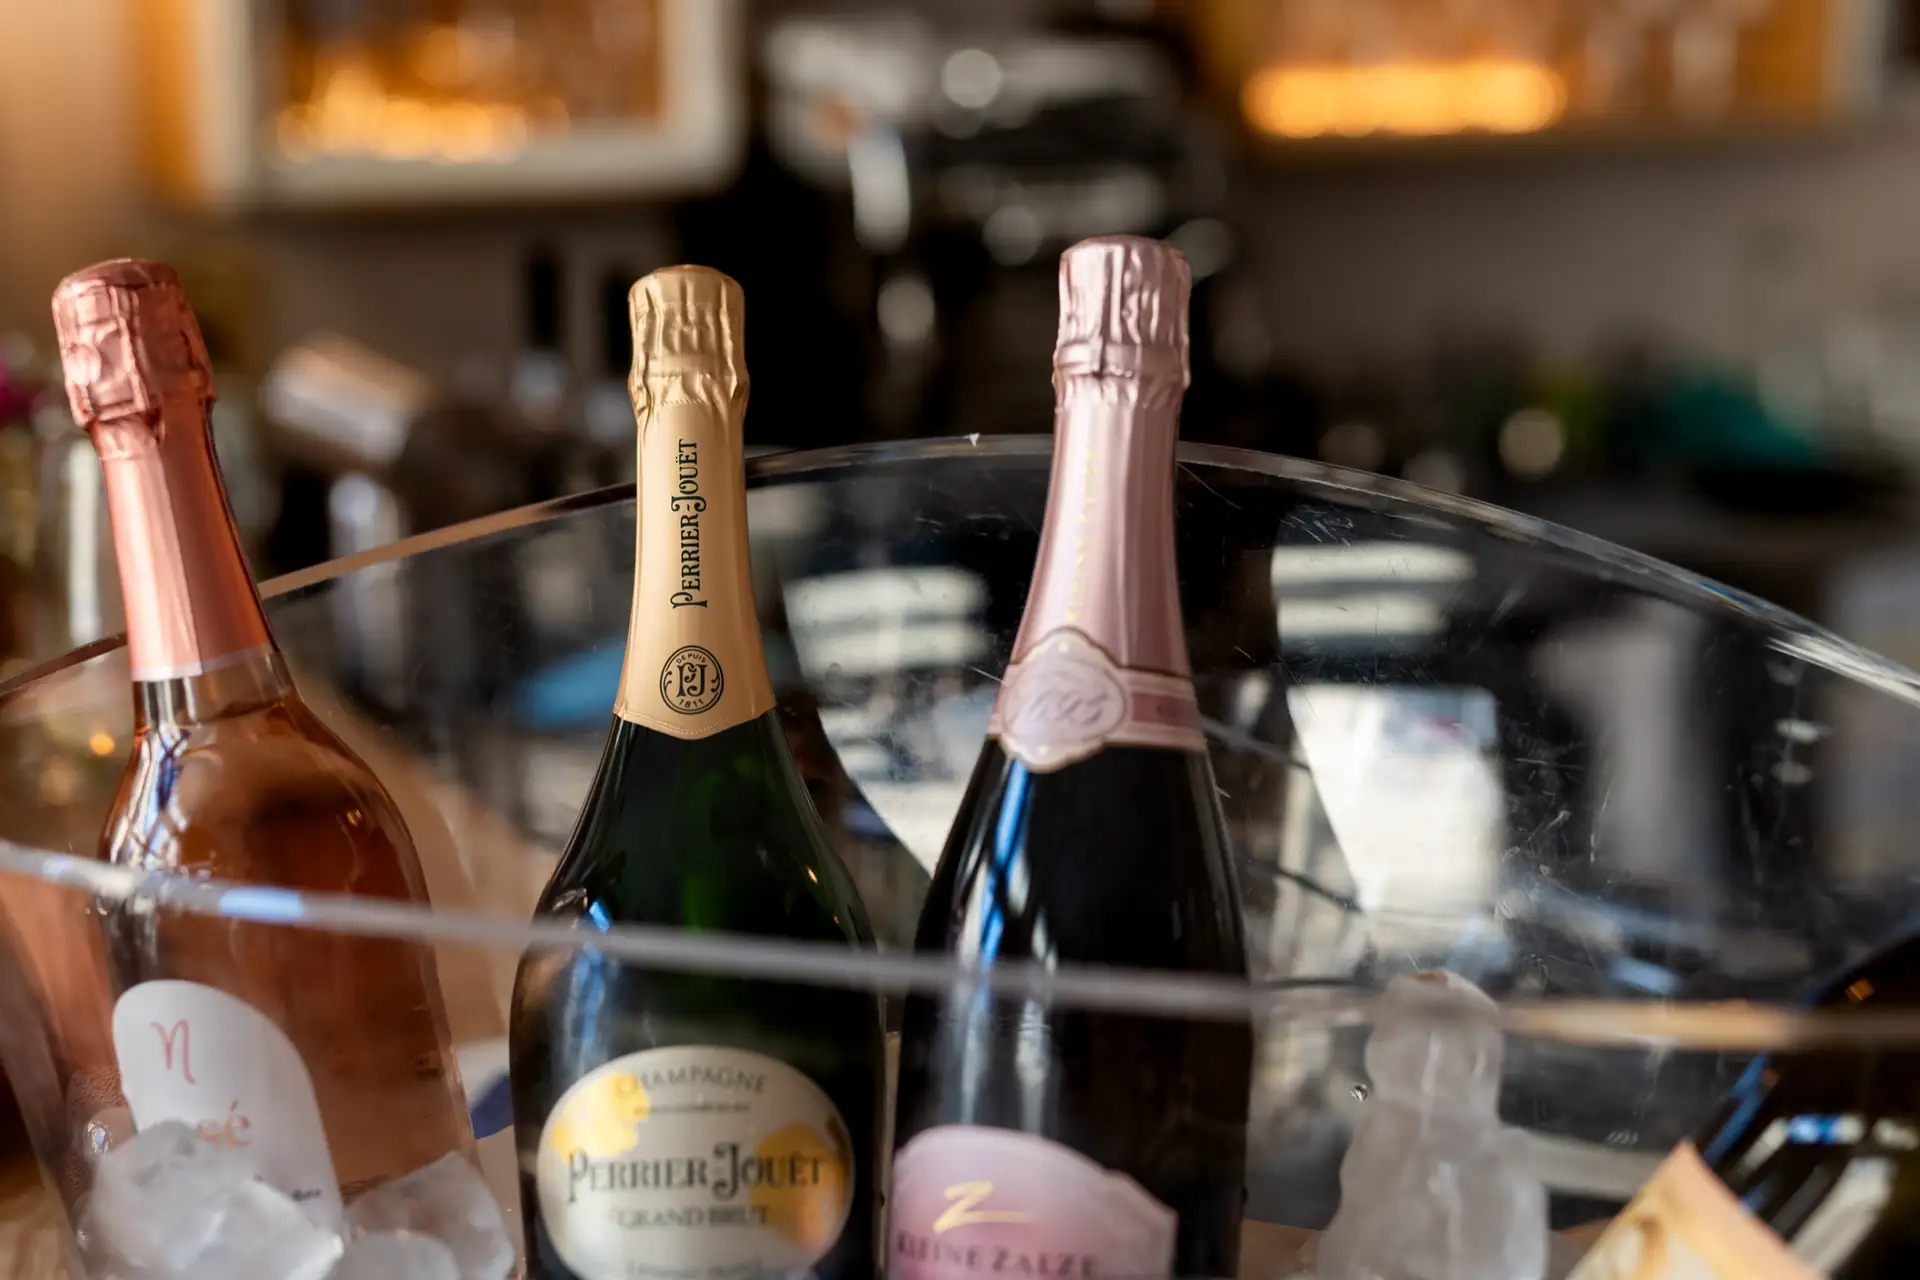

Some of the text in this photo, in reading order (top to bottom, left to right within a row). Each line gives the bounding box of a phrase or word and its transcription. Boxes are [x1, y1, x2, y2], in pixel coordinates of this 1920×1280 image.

[679, 698, 704, 709] 1811
[616, 1206, 705, 1230] GRAND
[991, 1244, 1100, 1280] ZALZE
